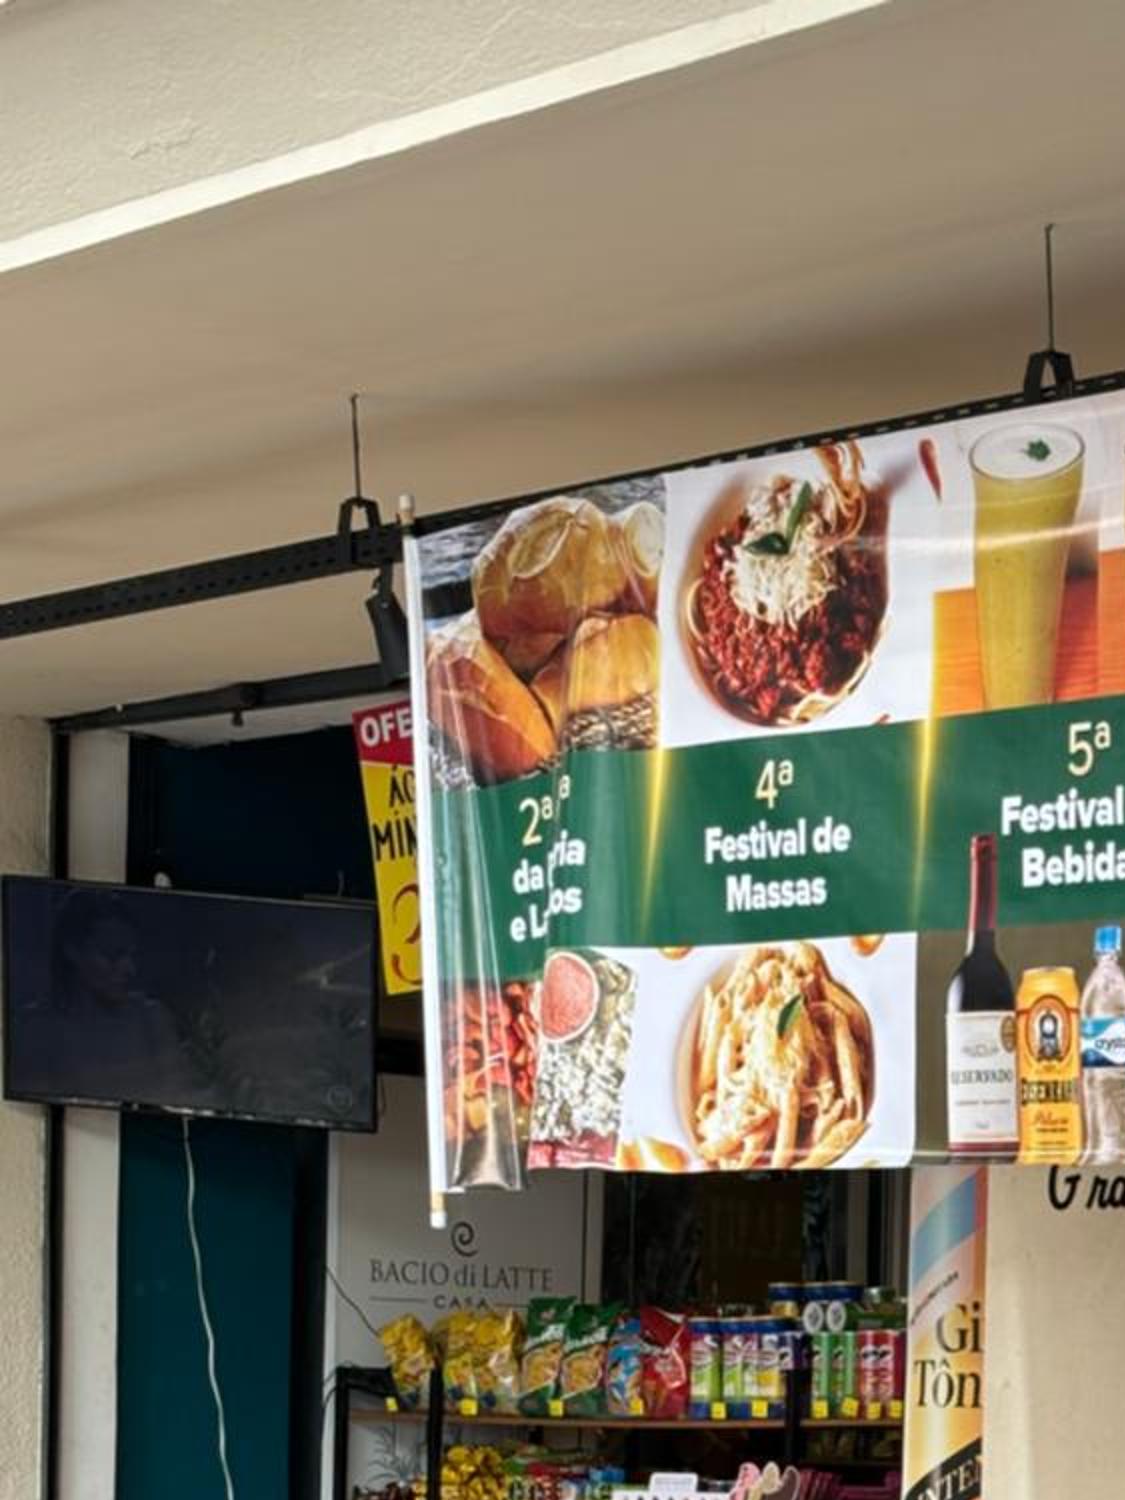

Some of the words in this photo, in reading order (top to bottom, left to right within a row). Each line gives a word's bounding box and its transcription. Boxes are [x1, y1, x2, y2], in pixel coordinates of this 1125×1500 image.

[1068, 721, 1111, 776] 5ª
[755, 758, 794, 809] 4ª
[1002, 785, 1123, 836] Festival
[704, 817, 806, 864] Festival
[812, 818, 851, 853] de
[512, 858, 544, 894] da
[726, 874, 826, 912] Massas
[510, 917, 527, 942] e
[369, 1259, 449, 1286] BACIO
[455, 1264, 475, 1288] di
[483, 1264, 552, 1293] LATTE
[914, 1357, 983, 1409] Tôn
